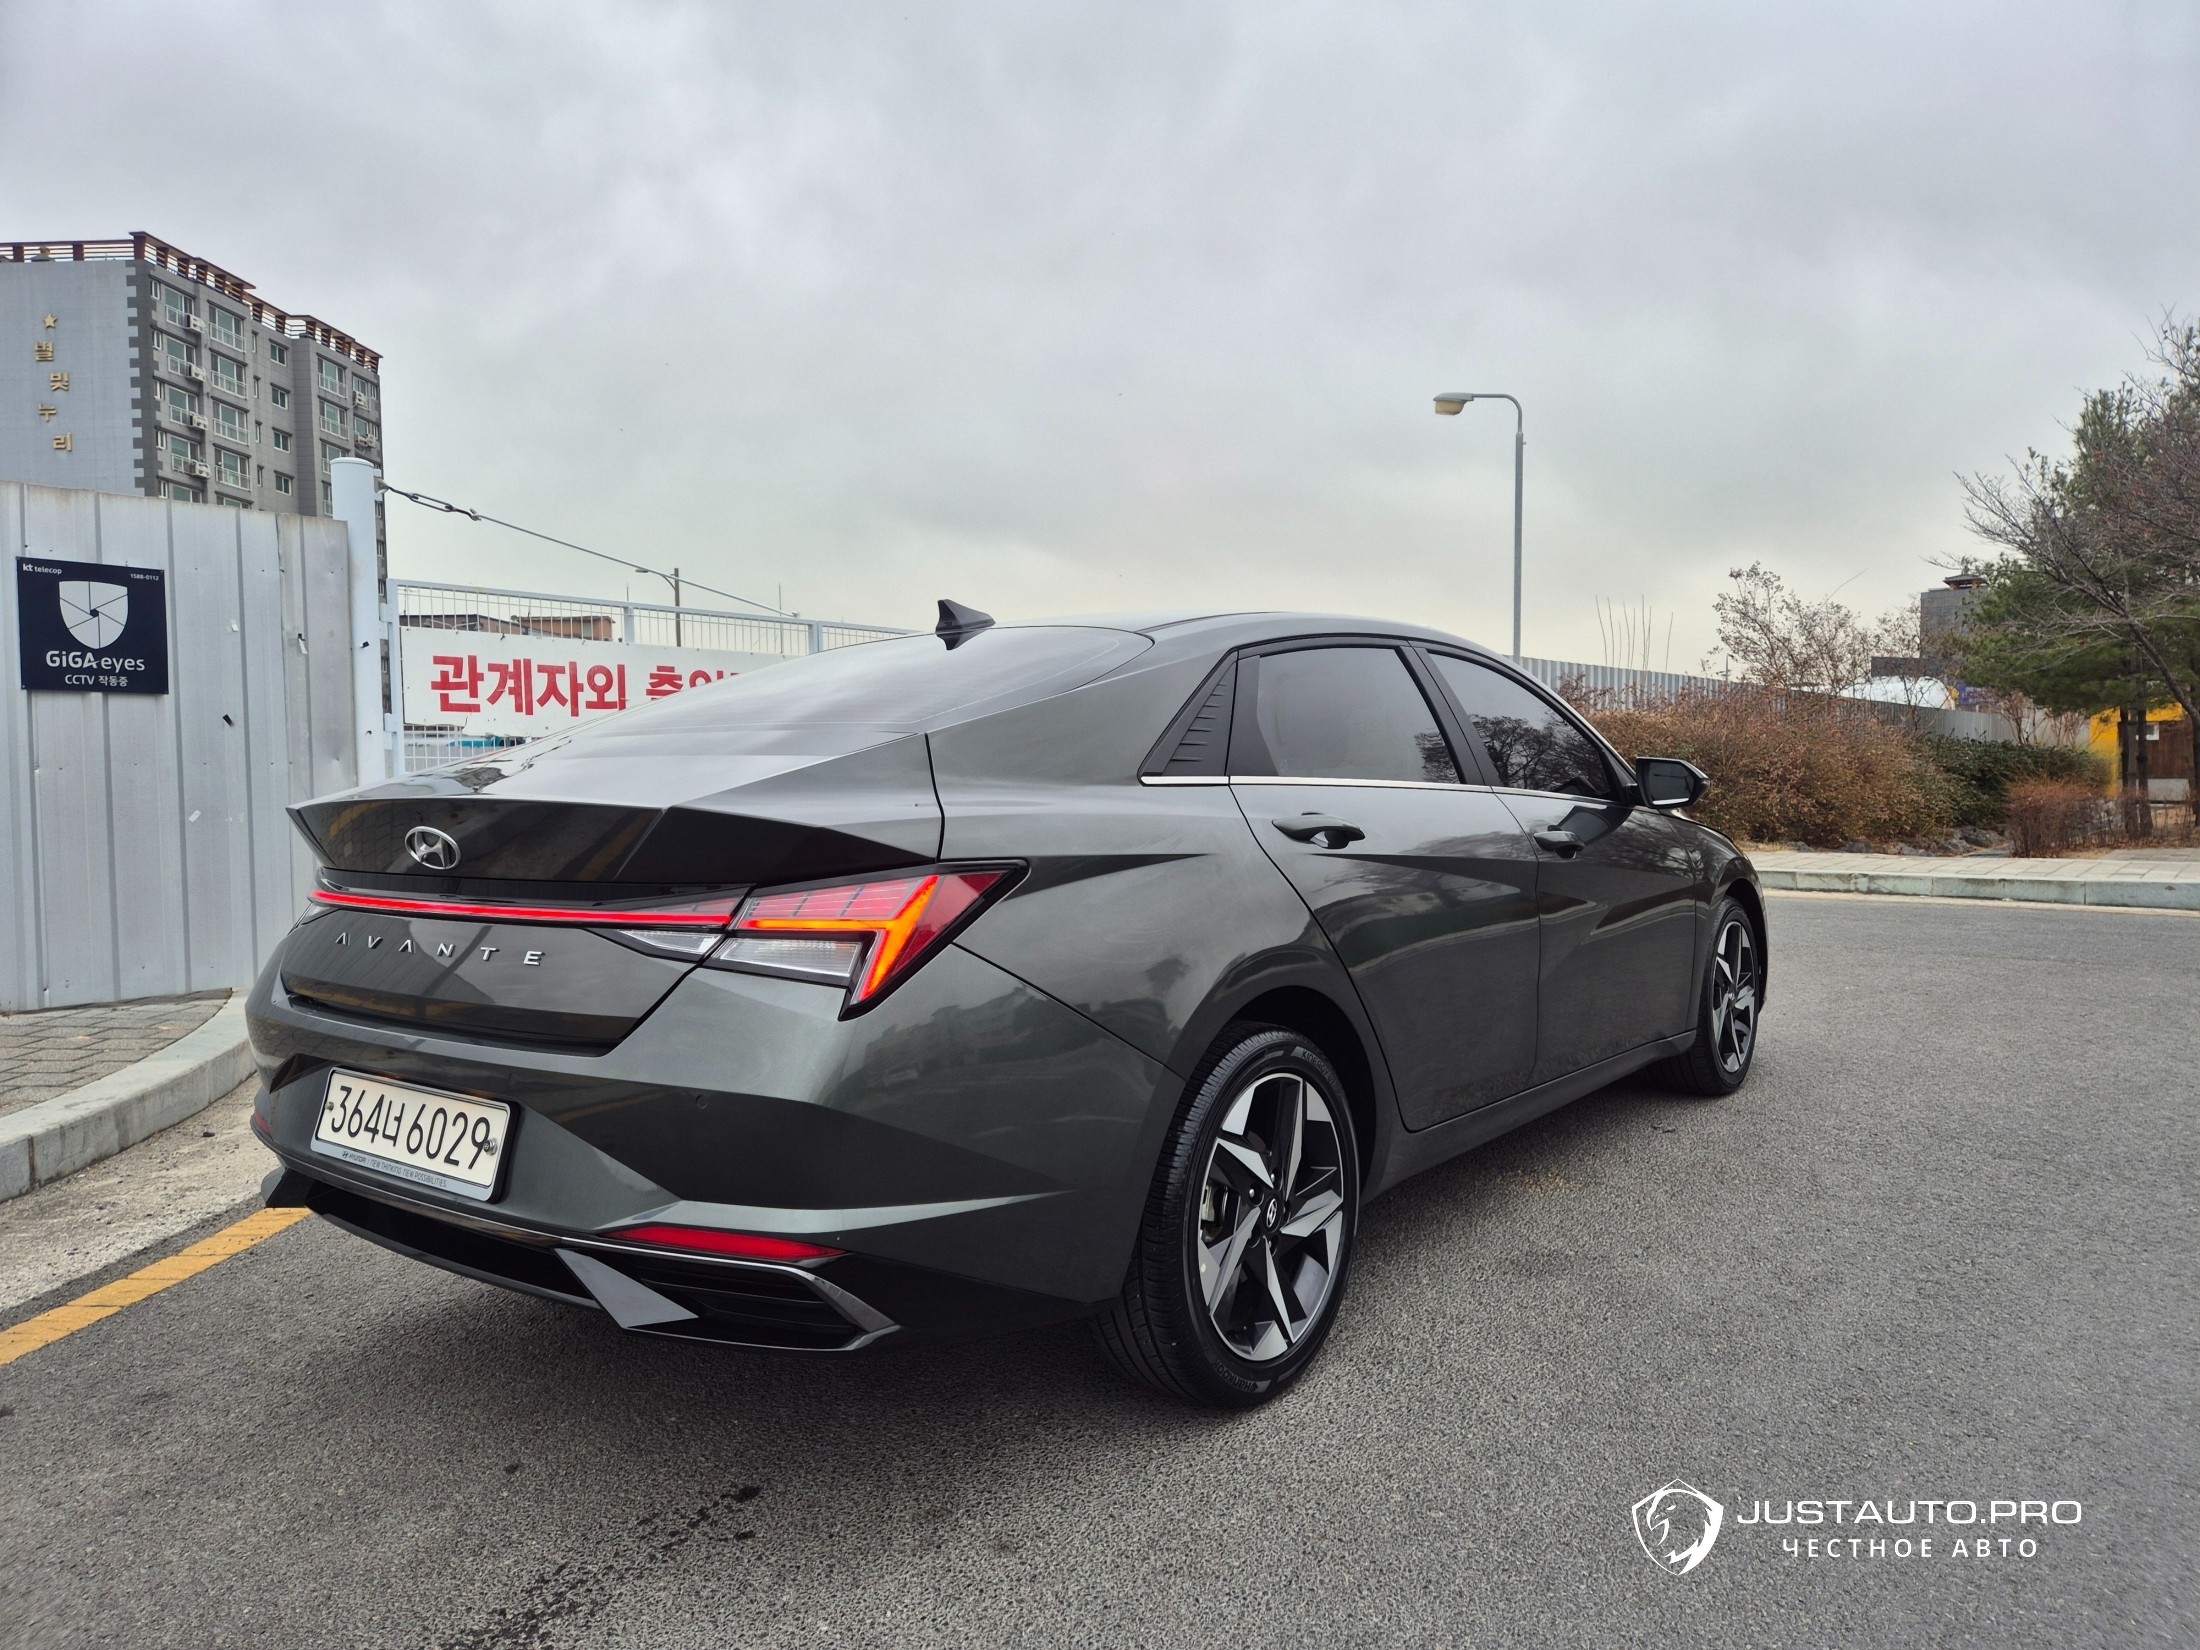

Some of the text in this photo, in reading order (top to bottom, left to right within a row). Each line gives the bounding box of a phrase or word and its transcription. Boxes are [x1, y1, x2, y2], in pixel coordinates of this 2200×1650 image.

[22, 563, 63, 575] kt telecop
[130, 573, 160, 582] 1588-0112
[100, 656, 146, 674] eyes
[64, 674, 129, 688] CCTV 작동중
[430, 654, 627, 718] 관계자외
[335, 931, 545, 967] AVANTE
